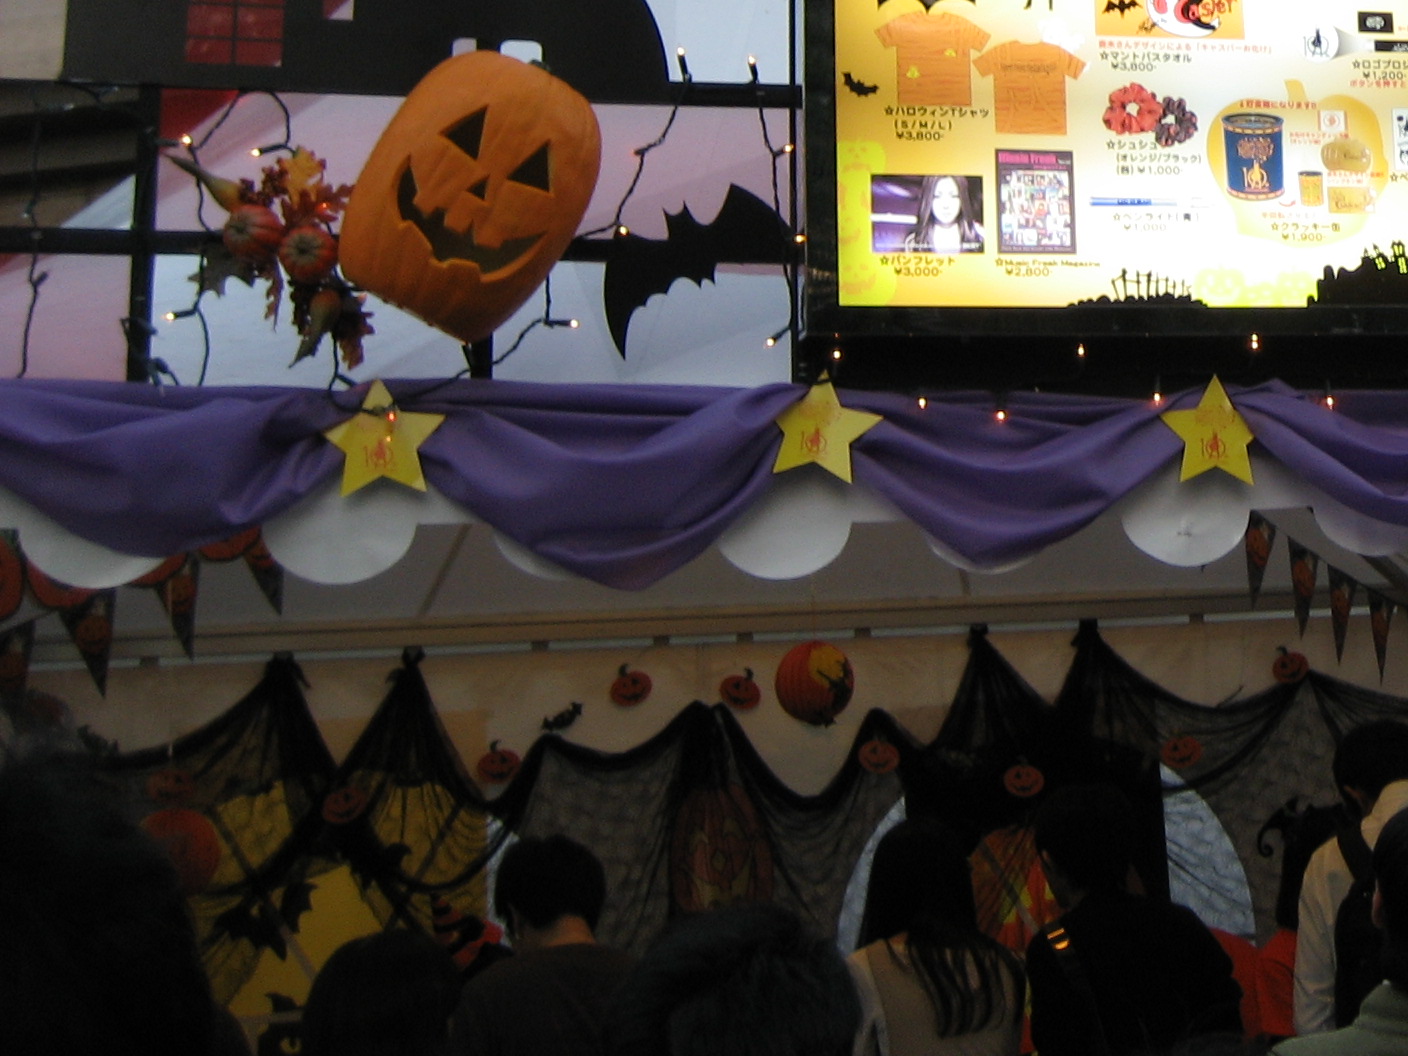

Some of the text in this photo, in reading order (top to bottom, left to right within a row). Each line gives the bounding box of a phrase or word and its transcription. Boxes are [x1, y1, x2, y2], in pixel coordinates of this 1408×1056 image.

[895, 105, 990, 118] ハロウィンTシャツ
